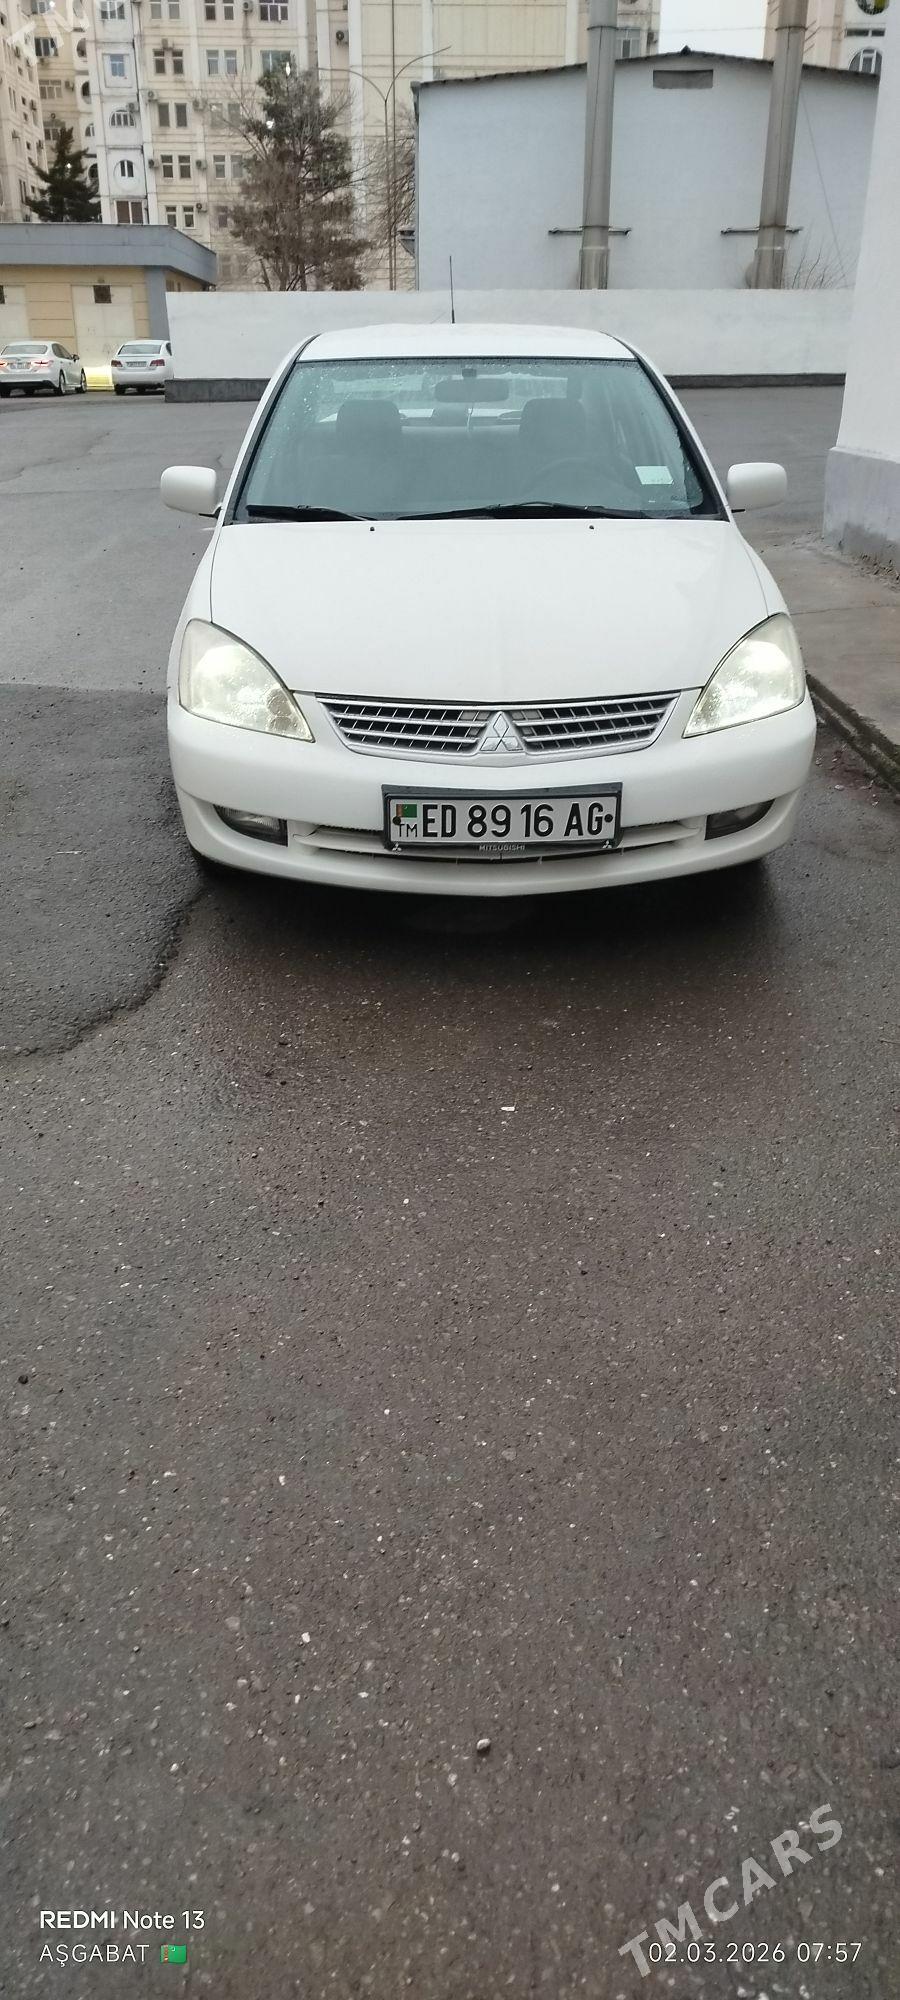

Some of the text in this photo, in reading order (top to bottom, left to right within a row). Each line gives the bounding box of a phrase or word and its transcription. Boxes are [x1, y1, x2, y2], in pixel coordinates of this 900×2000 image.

[399, 823, 418, 838] TM
[422, 802, 604, 838] ED 89 16 AG
